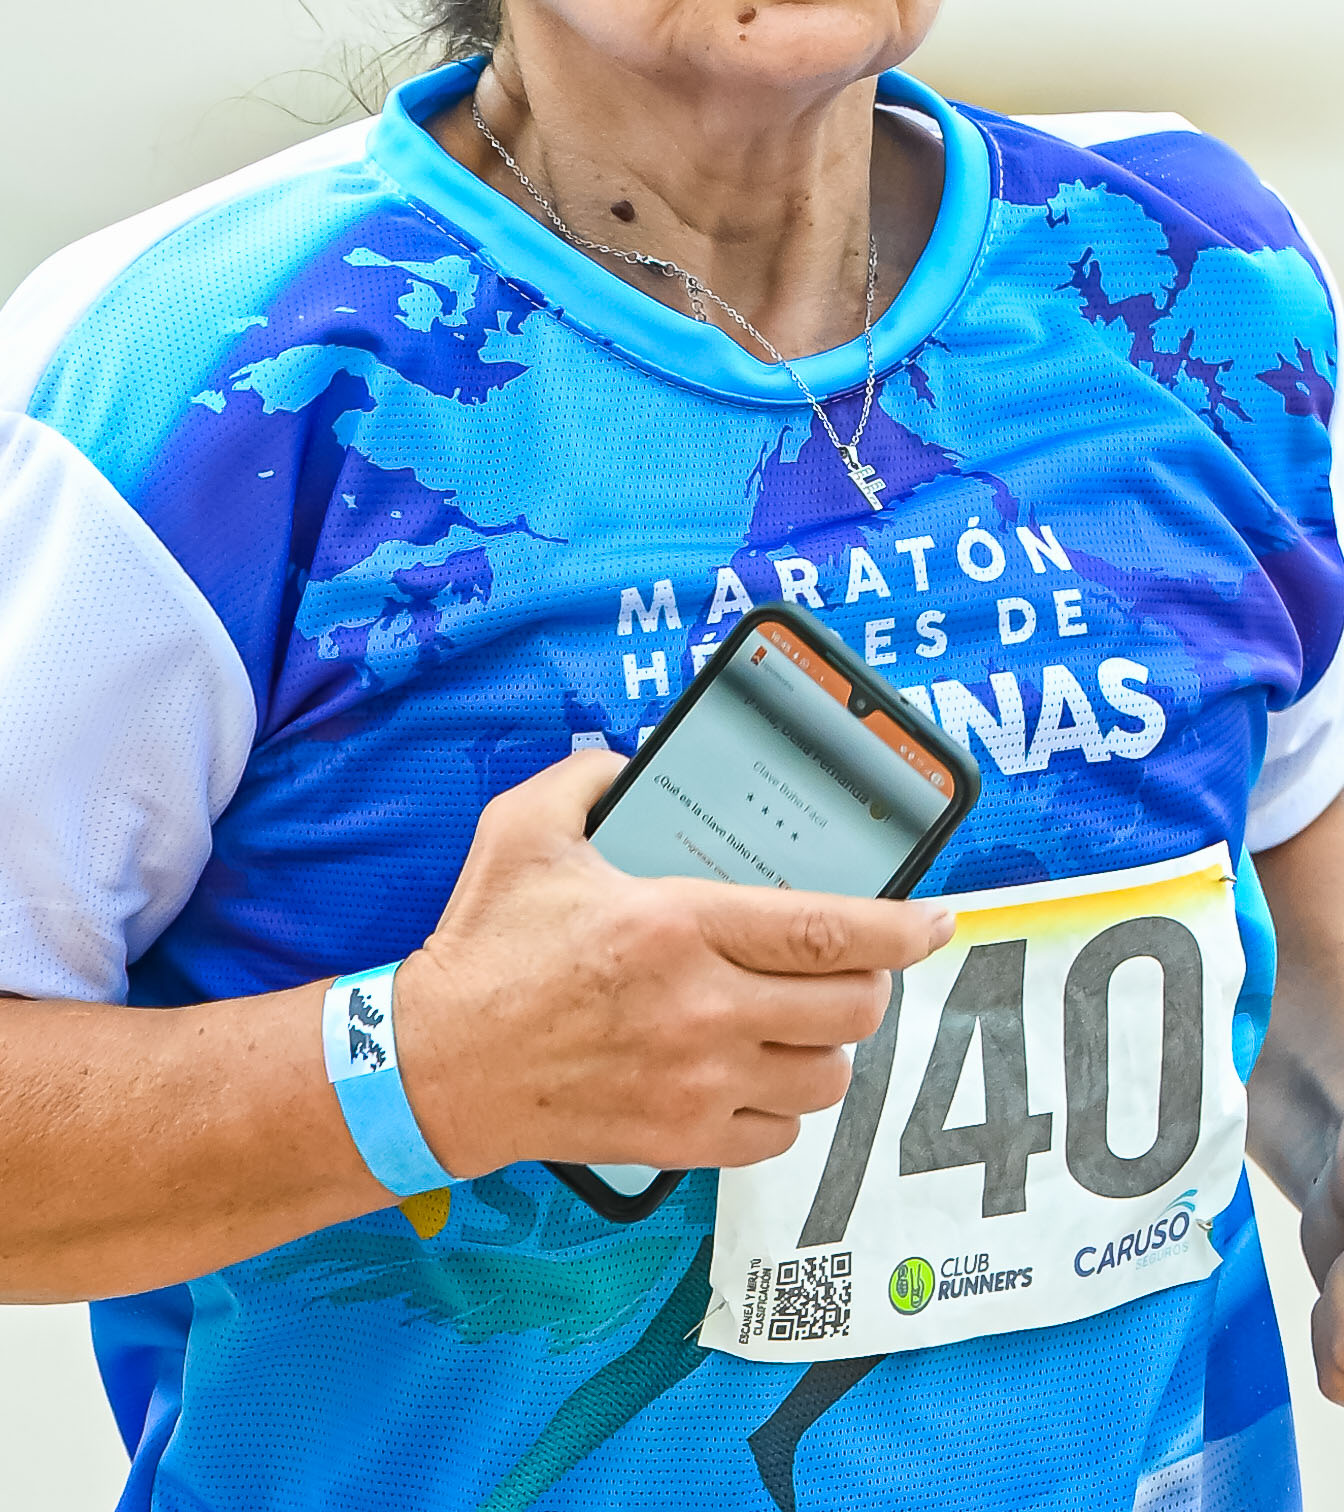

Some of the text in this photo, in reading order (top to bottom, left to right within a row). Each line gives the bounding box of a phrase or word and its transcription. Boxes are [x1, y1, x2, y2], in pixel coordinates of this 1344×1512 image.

[616, 516, 1073, 637] MARATÓN
[998, 589, 1088, 646] DE
[940, 1253, 990, 1278] CLUB
[1074, 1211, 1190, 1277] CARUSO
[1135, 1243, 1189, 1271] SEGUROS
[753, 1268, 772, 1336] CLASIFICACIÓN
[937, 1267, 1033, 1301] RUNNER'S
